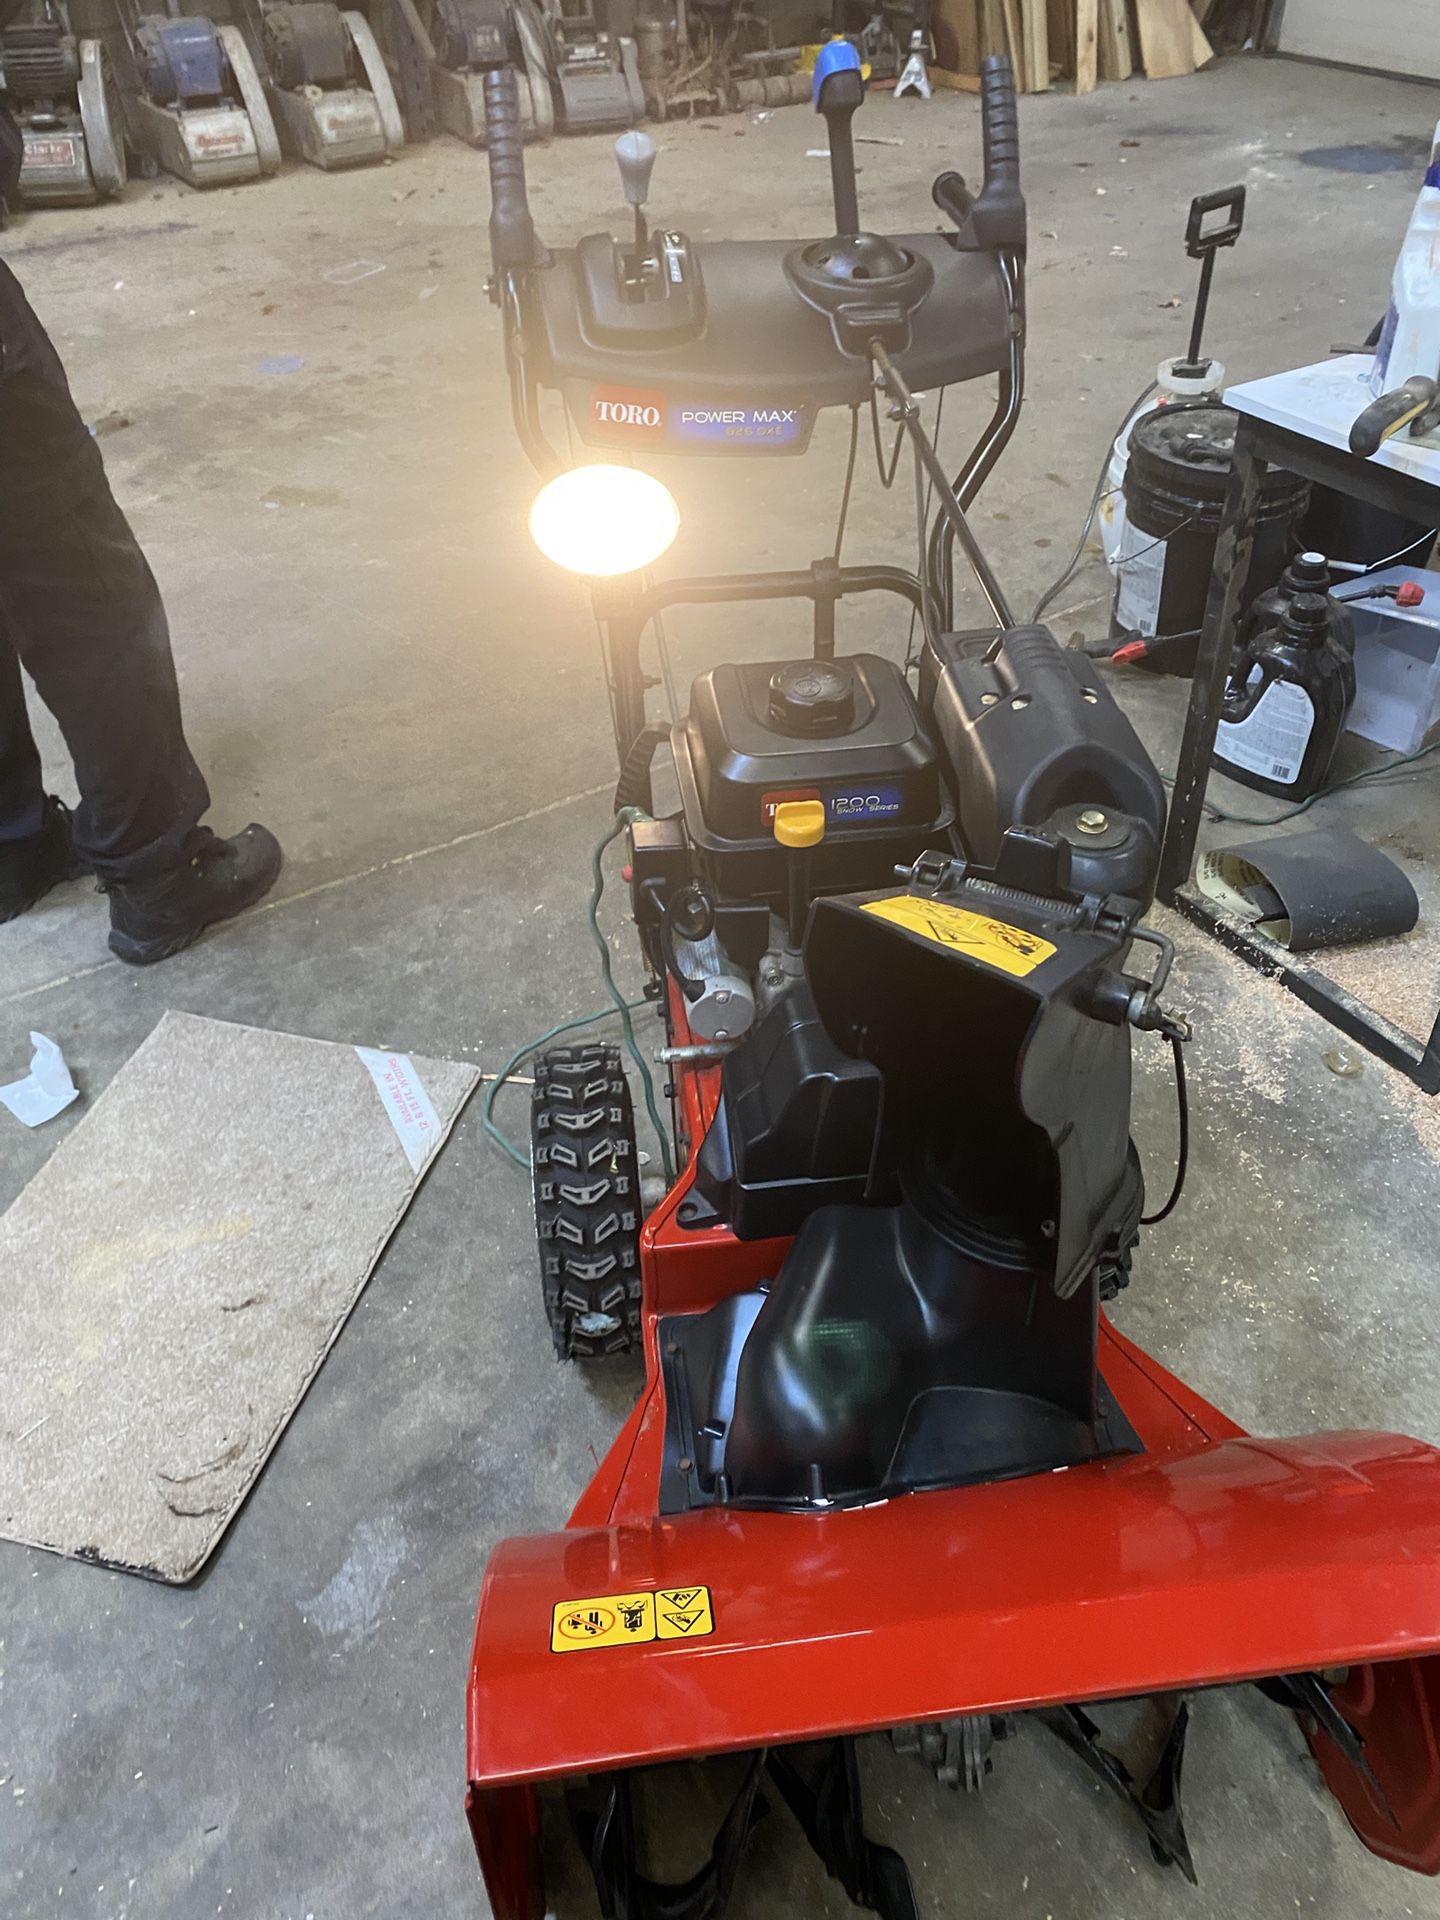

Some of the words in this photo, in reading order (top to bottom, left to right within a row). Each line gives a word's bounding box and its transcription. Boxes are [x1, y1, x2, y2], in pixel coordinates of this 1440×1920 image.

[595, 401, 660, 426] TORO
[682, 411, 745, 424] POWER
[752, 410, 794, 423] MAX
[831, 796, 880, 810] 1200
[869, 804, 899, 812] SERIES
[384, 1072, 393, 1082] IN
[389, 1085, 414, 1123] AVAILABLE
